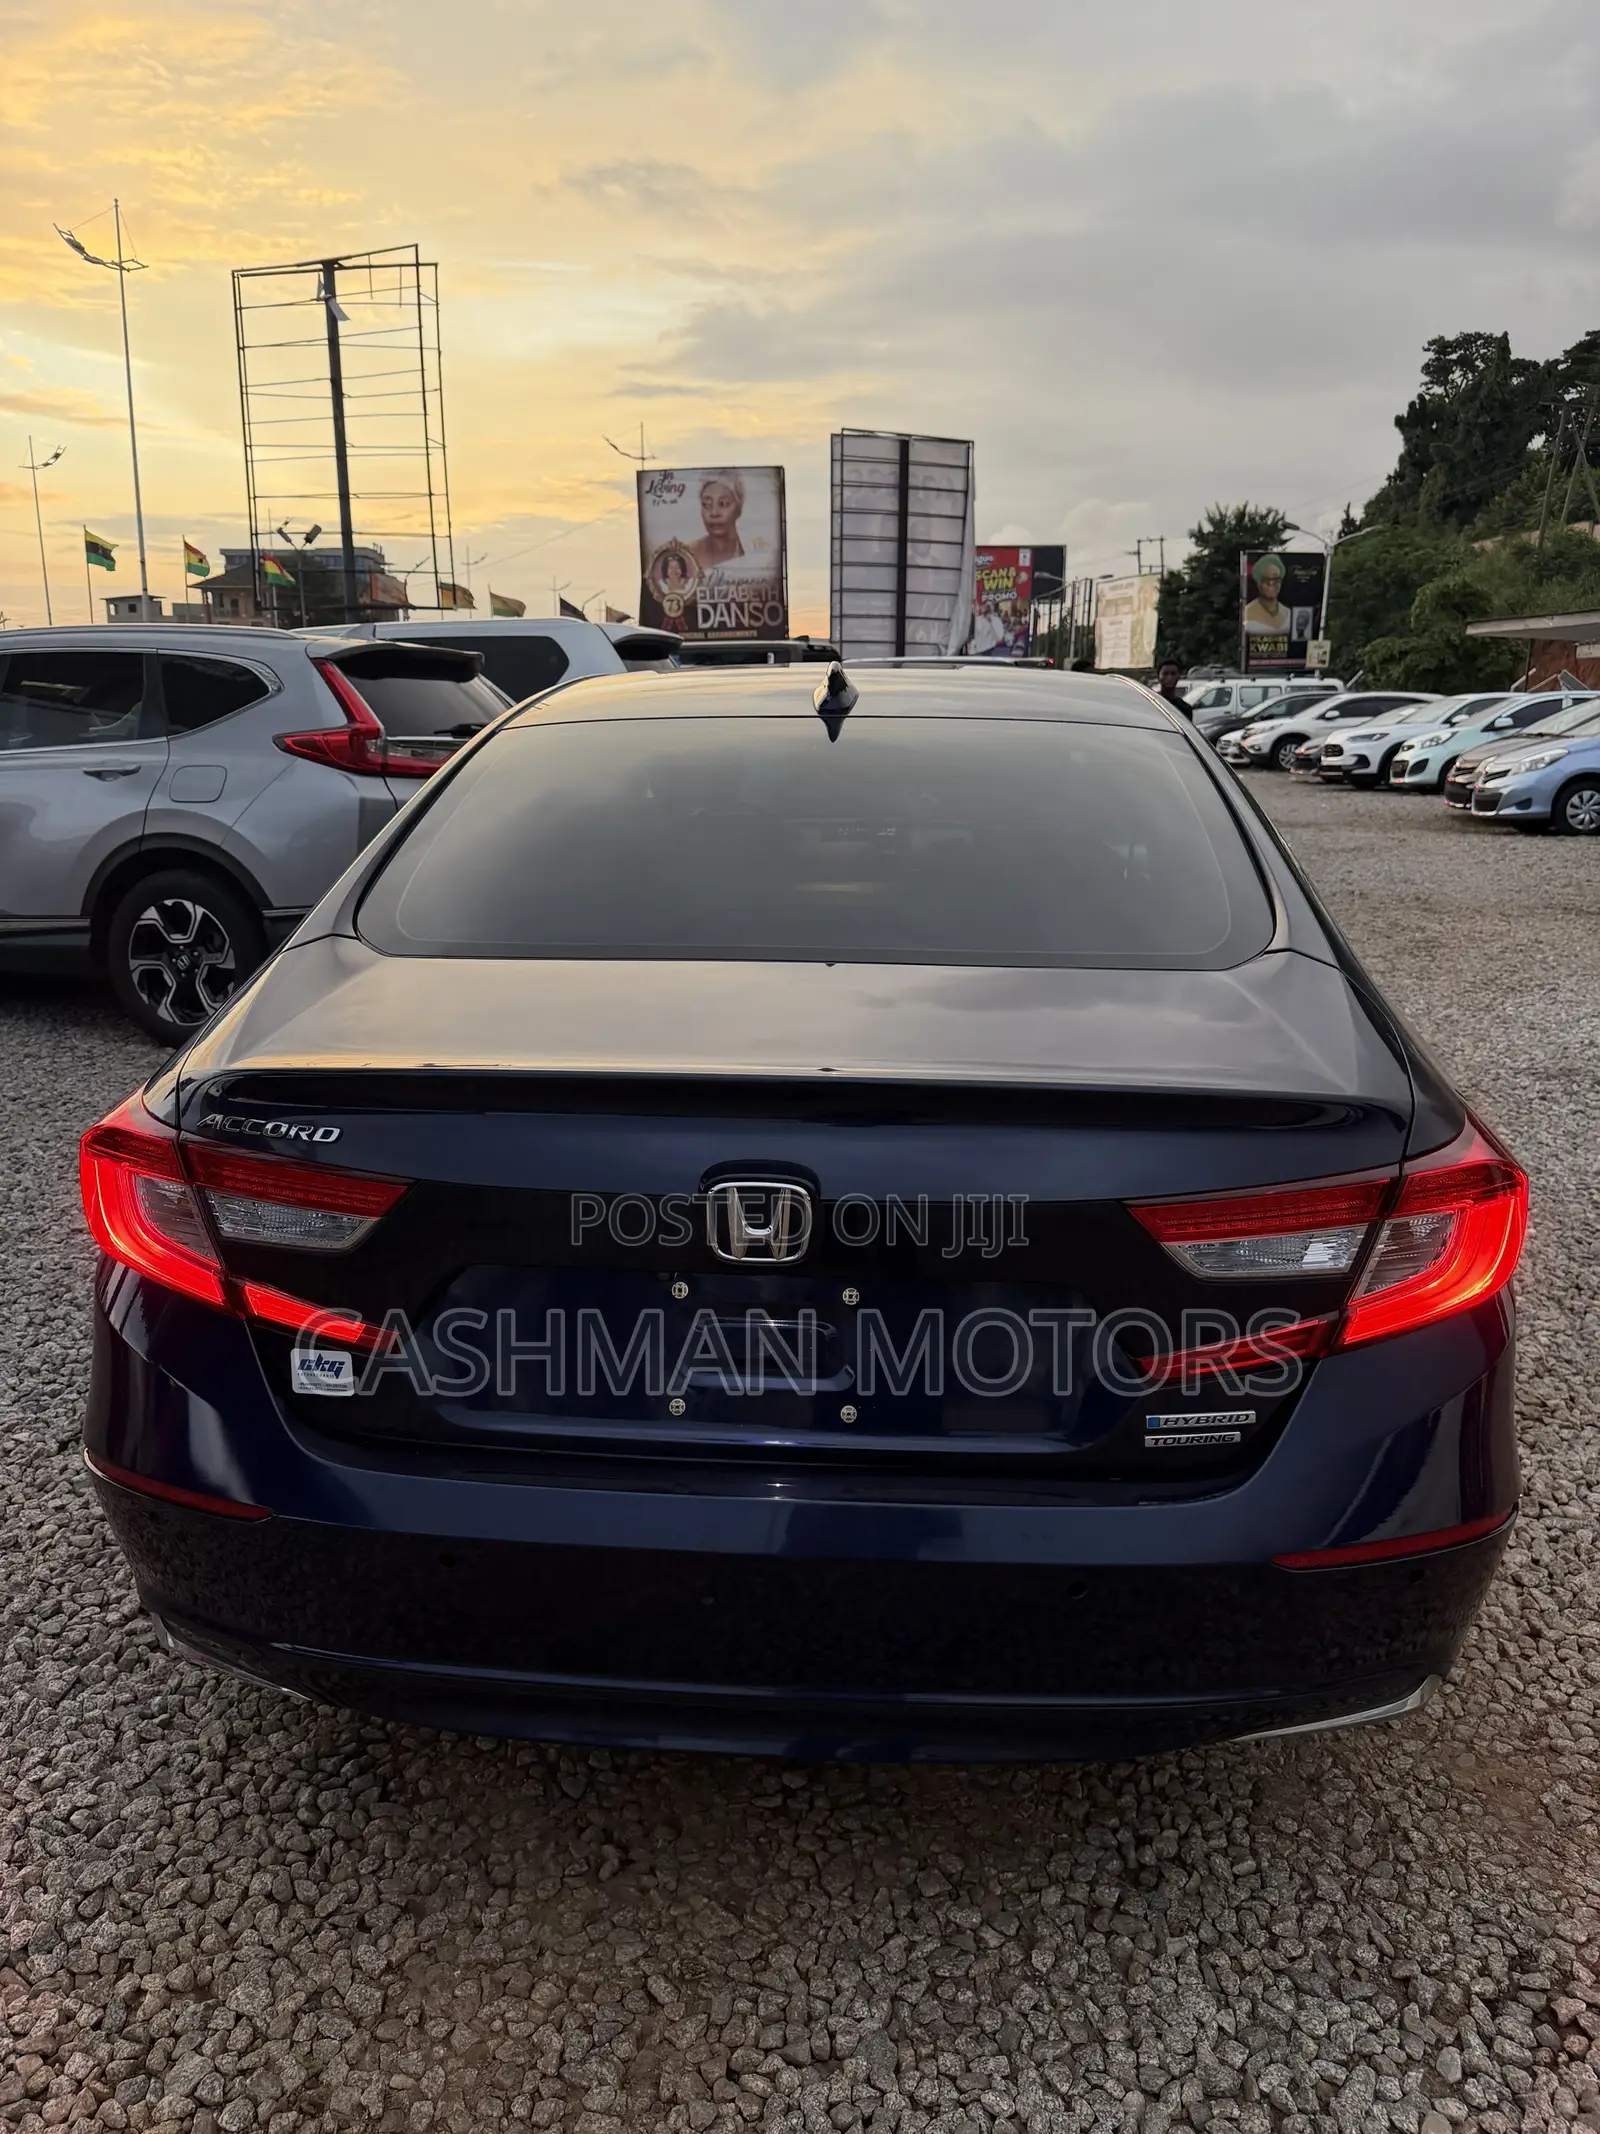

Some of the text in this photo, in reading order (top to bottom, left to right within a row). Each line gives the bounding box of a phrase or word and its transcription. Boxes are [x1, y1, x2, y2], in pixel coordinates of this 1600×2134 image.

[983, 577, 1014, 592] WIN
[696, 584, 779, 603] ELIZABETH
[981, 591, 1017, 603] PROMO
[697, 601, 783, 629] DANSO
[1249, 642, 1289, 653] KWABI
[197, 1113, 341, 1143] ACCORD
[1163, 1413, 1250, 1426] HYBRID
[1151, 1434, 1235, 1446] TOURING
